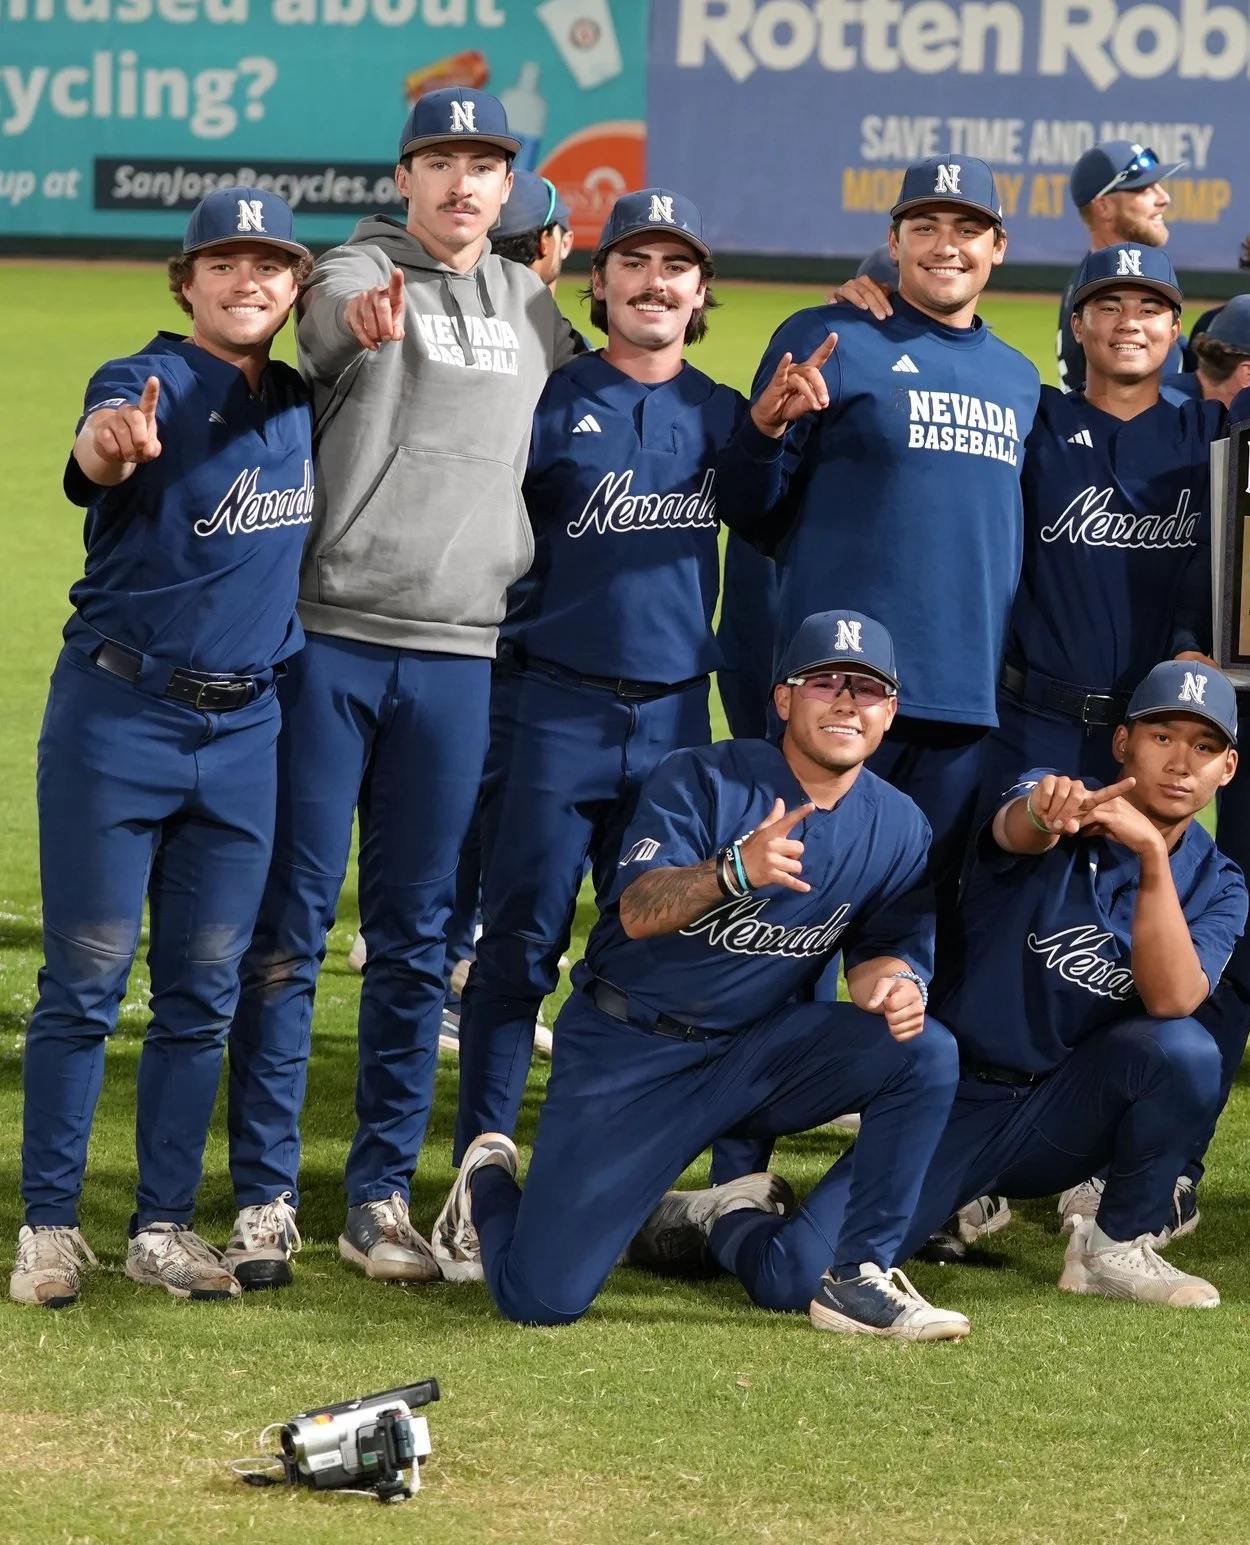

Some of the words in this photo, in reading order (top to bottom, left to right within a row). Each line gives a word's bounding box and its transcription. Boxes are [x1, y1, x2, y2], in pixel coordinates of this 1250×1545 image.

[676, 0, 1025, 83] Rotten
[449, 100, 477, 132] N
[860, 114, 941, 162] SAVE
[949, 117, 1025, 165] TIME
[1028, 119, 1095, 167] AND
[42, 167, 84, 200] at
[933, 163, 962, 194] N
[237, 199, 265, 232] N
[648, 194, 676, 223] N
[1160, 177, 1233, 224] UMP
[1116, 249, 1145, 276] N
[908, 389, 1020, 442] NEVADA
[908, 424, 1018, 467] BASEBALL
[835, 619, 864, 652] N
[1177, 671, 1207, 706] N
